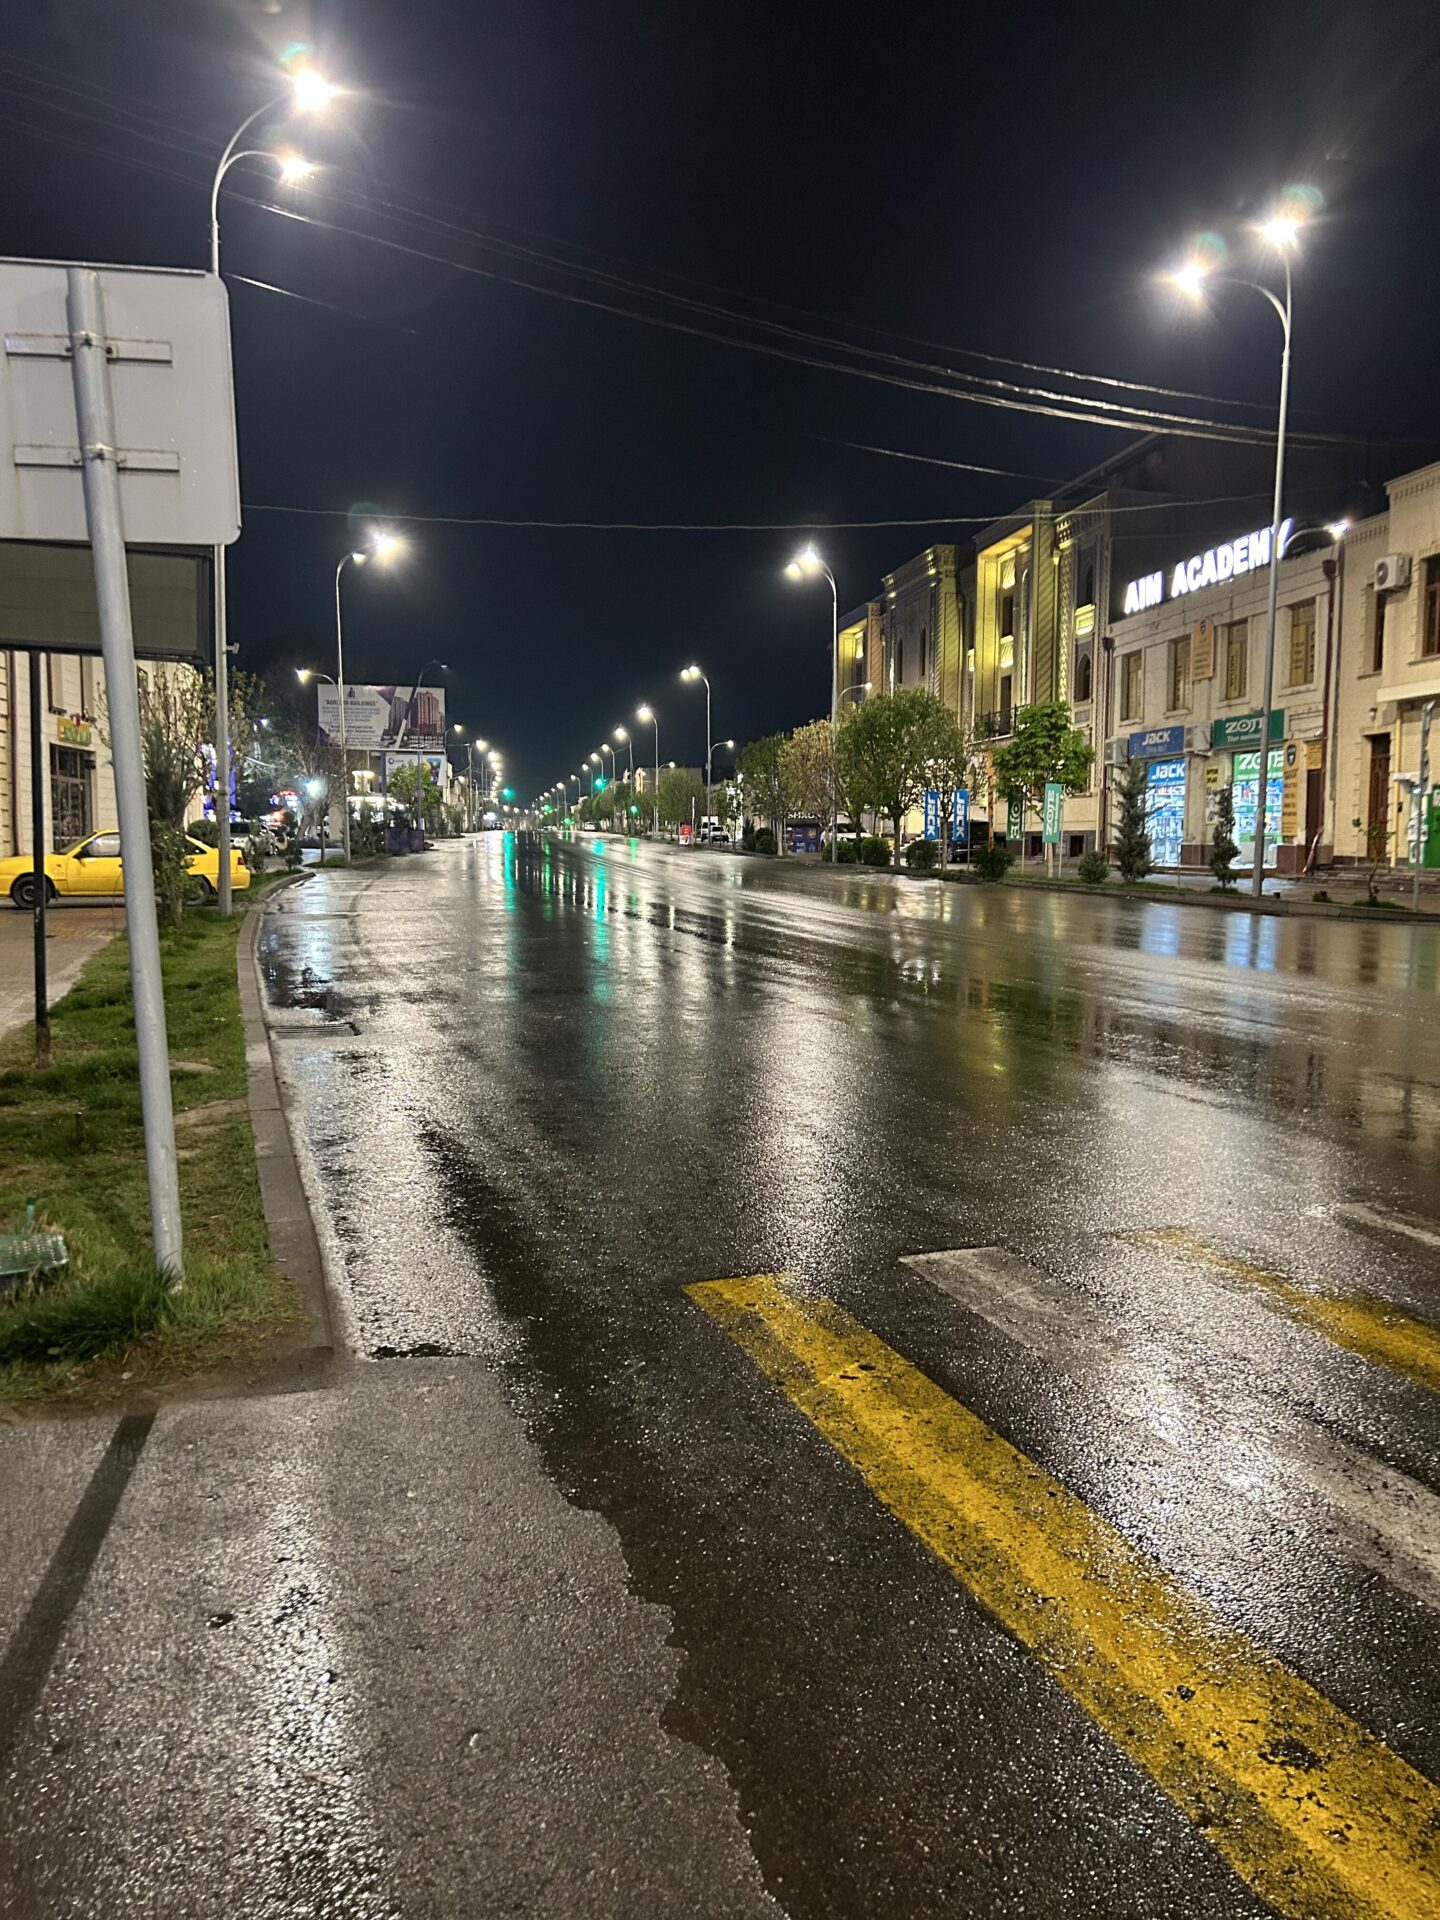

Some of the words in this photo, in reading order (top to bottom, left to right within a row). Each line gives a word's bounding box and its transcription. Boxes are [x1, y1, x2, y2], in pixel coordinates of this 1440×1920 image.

[1124, 570, 1164, 615] AIM
[1170, 517, 1293, 598] ACADEMY
[1010, 801, 1021, 839] OJE
